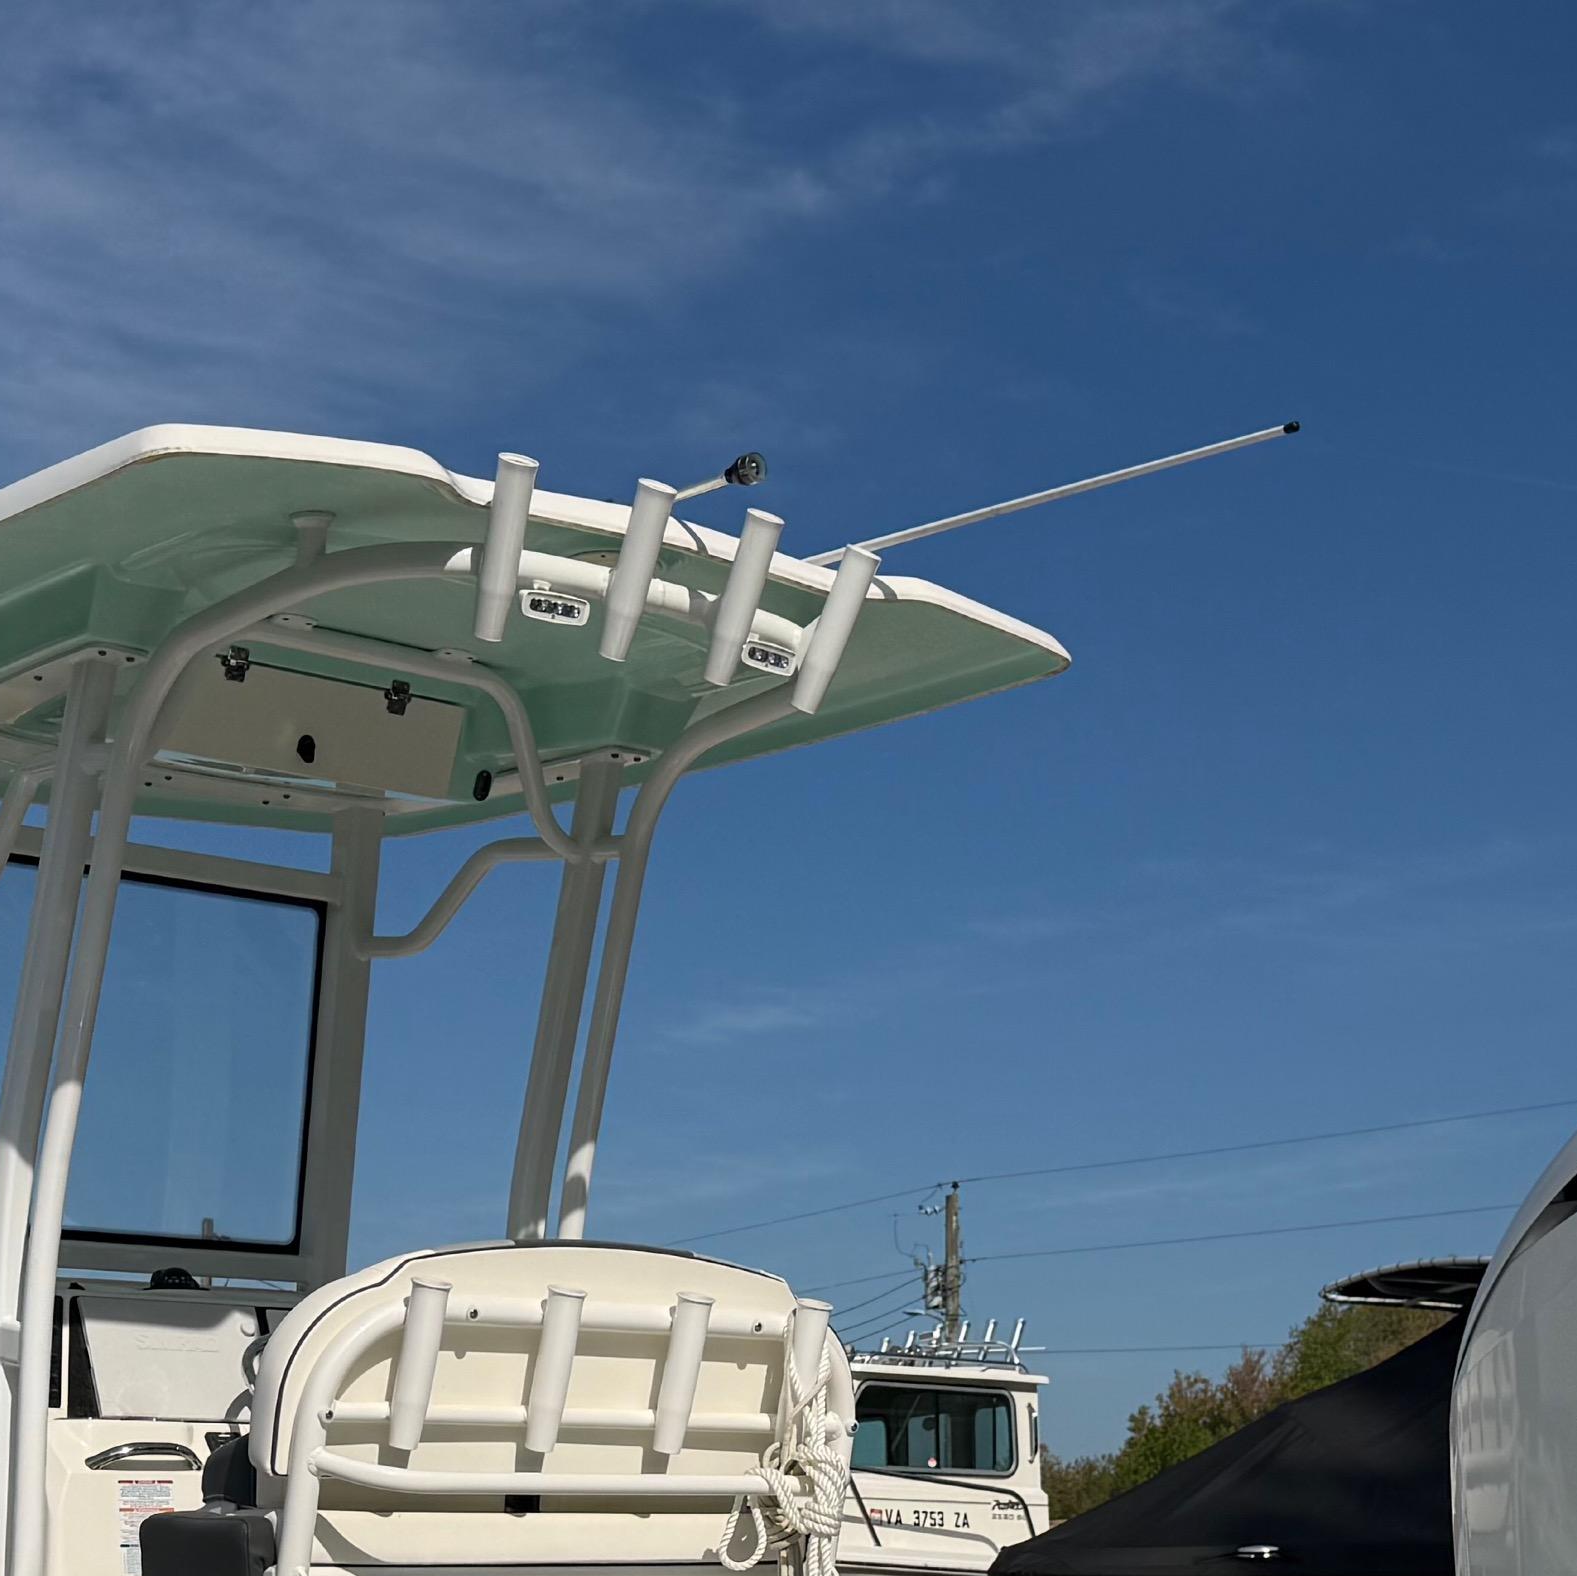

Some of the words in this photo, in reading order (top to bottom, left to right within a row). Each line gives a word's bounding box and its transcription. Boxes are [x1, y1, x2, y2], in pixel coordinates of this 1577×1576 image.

[885, 1509, 903, 1527] VA
[913, 1509, 945, 1528] 3753
[954, 1511, 970, 1529] ZA
